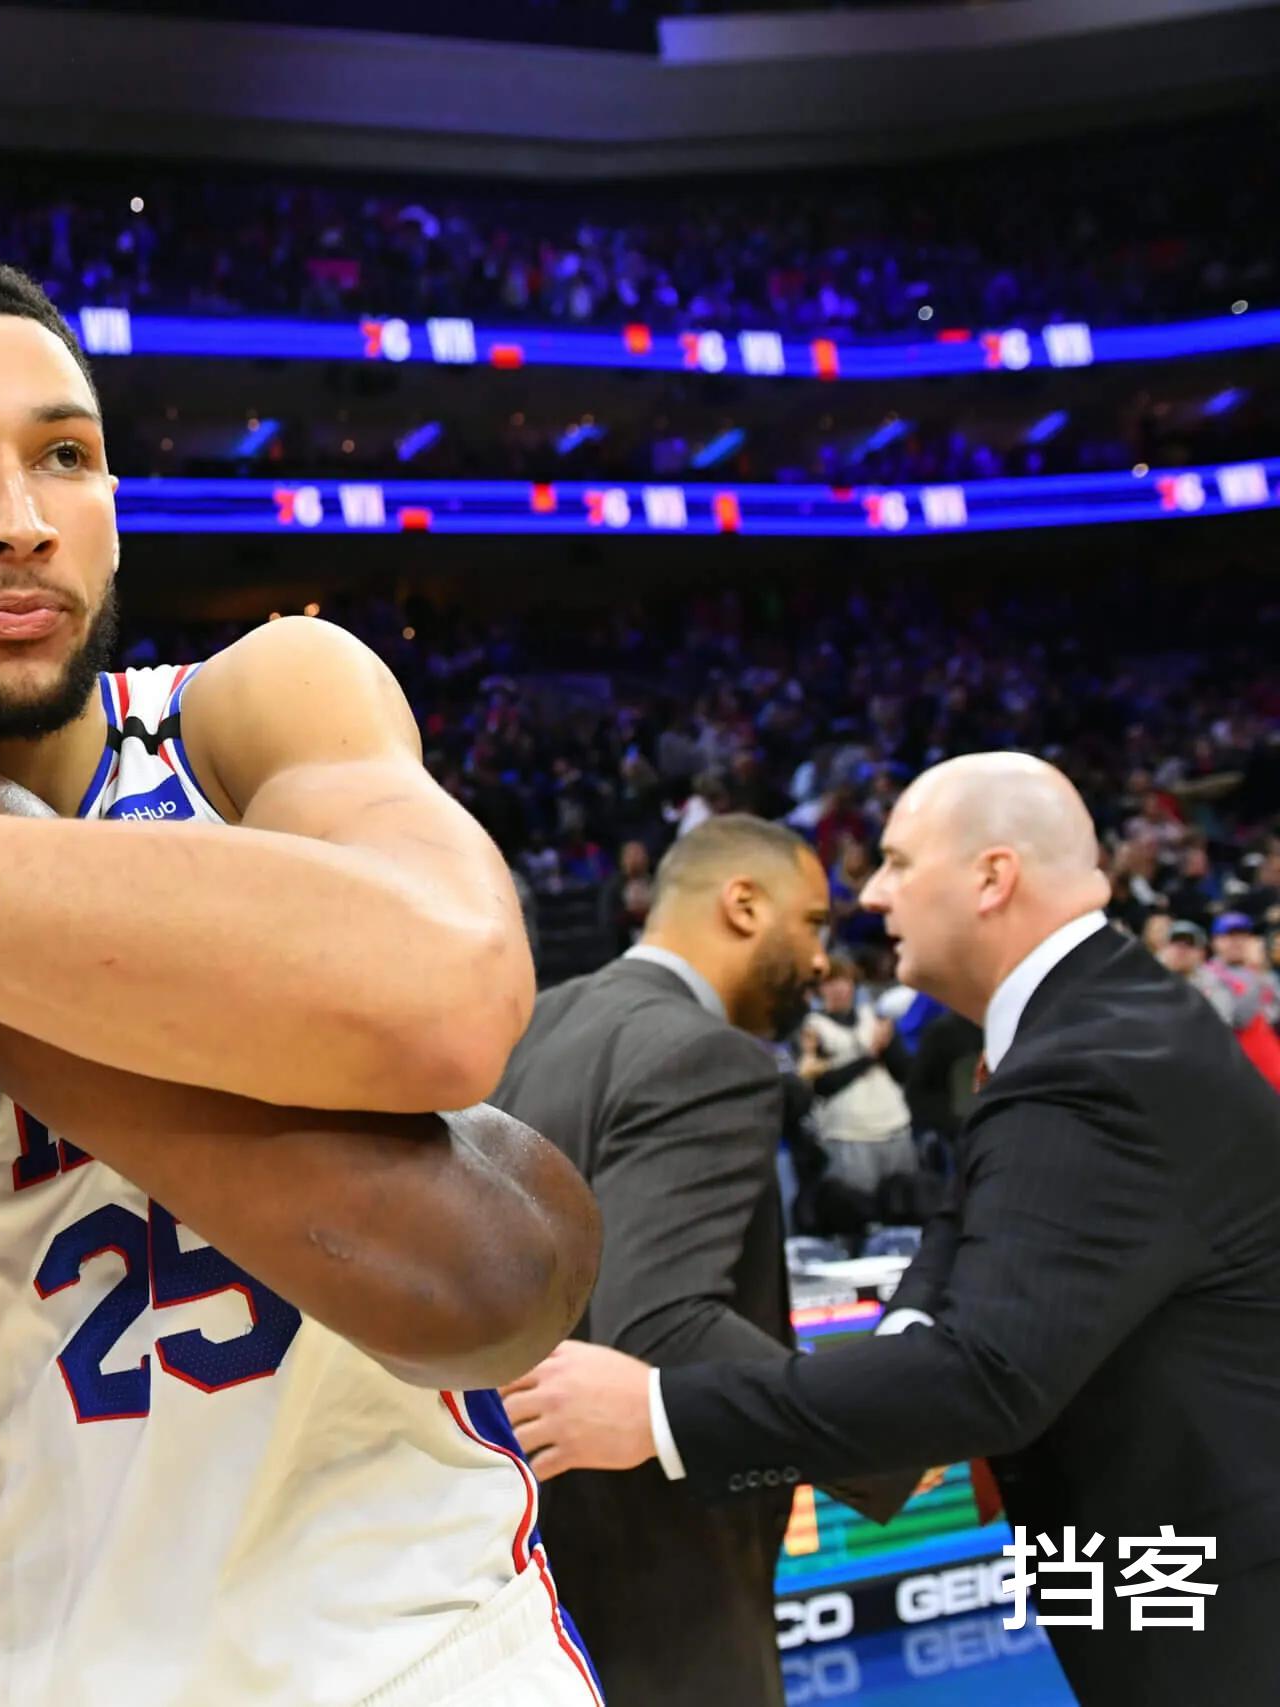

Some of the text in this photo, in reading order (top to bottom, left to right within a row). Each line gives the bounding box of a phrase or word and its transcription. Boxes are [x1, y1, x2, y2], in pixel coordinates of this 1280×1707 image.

[120, 800, 177, 821] bHub
[33, 1196, 302, 1423] 25
[775, 1557, 1031, 1649] CO GEIC
